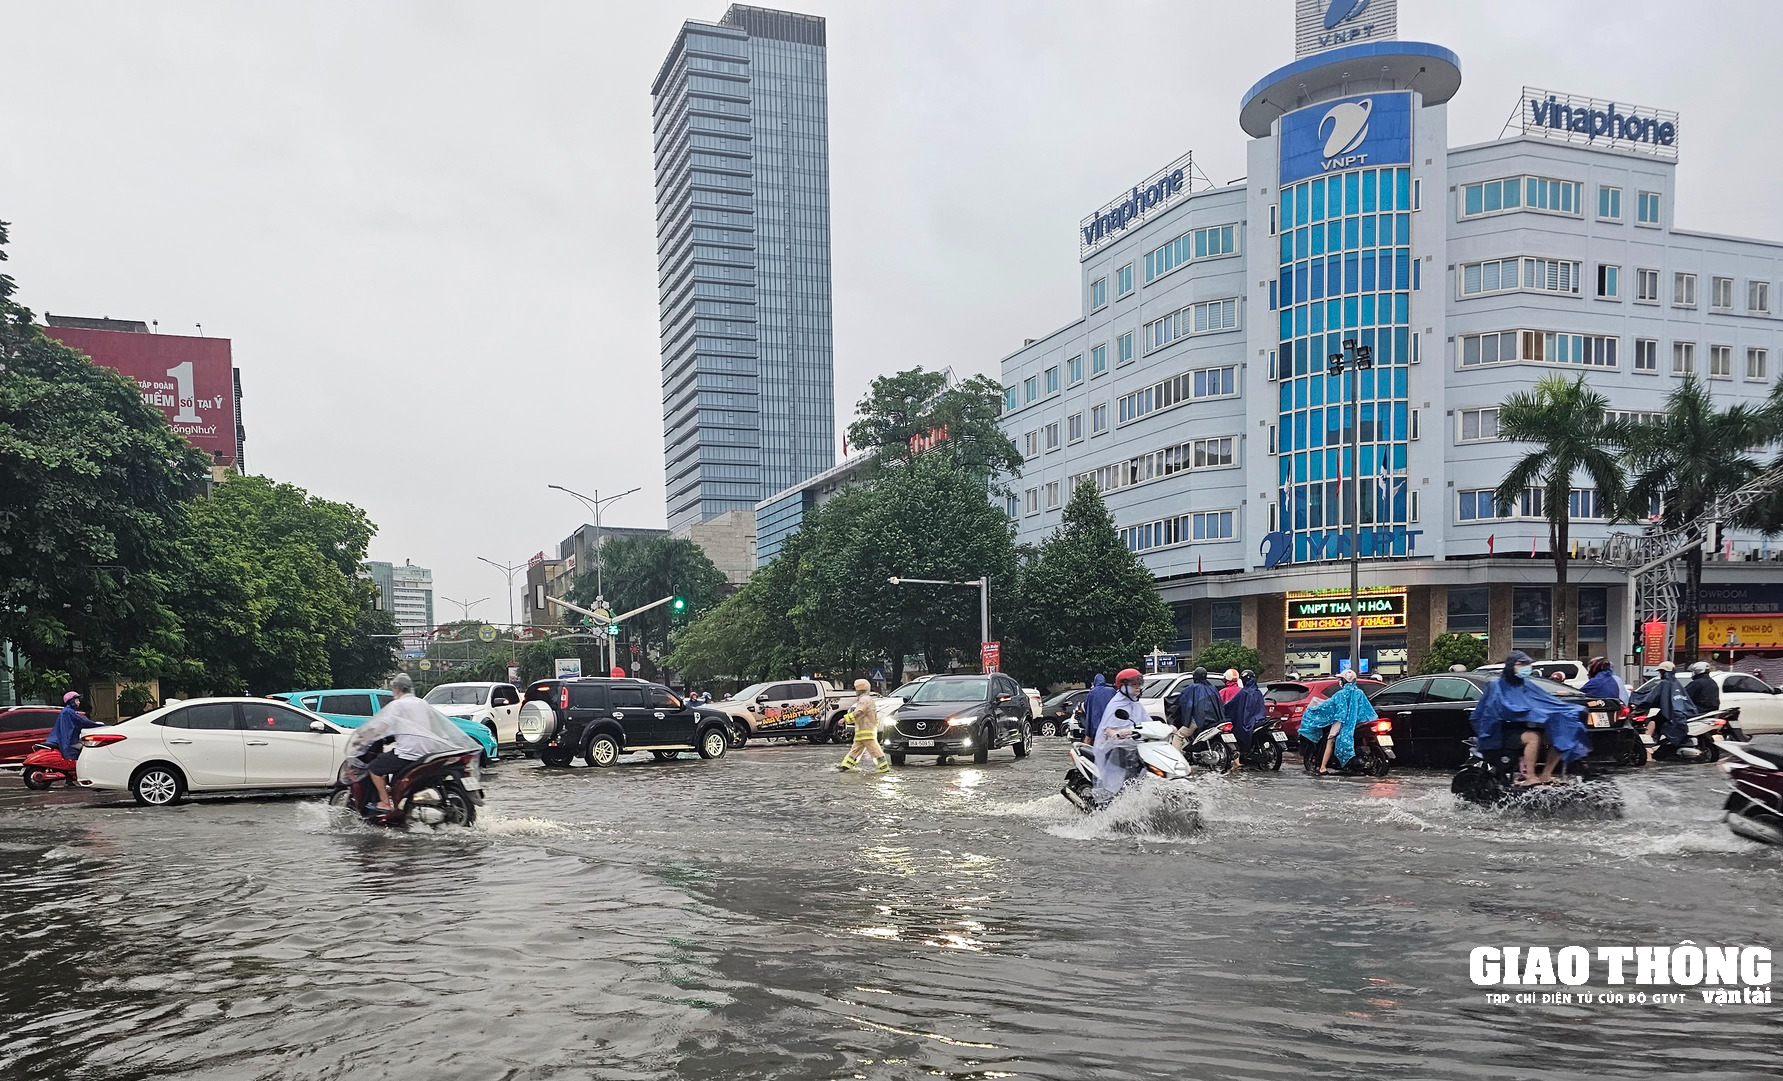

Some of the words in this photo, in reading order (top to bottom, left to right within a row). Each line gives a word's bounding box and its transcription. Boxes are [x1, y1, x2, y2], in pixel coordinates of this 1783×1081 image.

[1318, 24, 1374, 46] VNPT
[1531, 95, 1675, 146] vinaphone
[1320, 154, 1368, 171] VNPT
[1083, 168, 1184, 245] vinaphone
[153, 381, 174, 390] ĐOÀN
[166, 361, 202, 424] 1
[197, 400, 212, 411] TẠI
[214, 395, 223, 409] Ý
[1299, 603, 1328, 615] VNPT
[1329, 601, 1366, 614] THAH
[1343, 616, 1364, 627] QÝ
[1741, 625, 1760, 634] KINH
